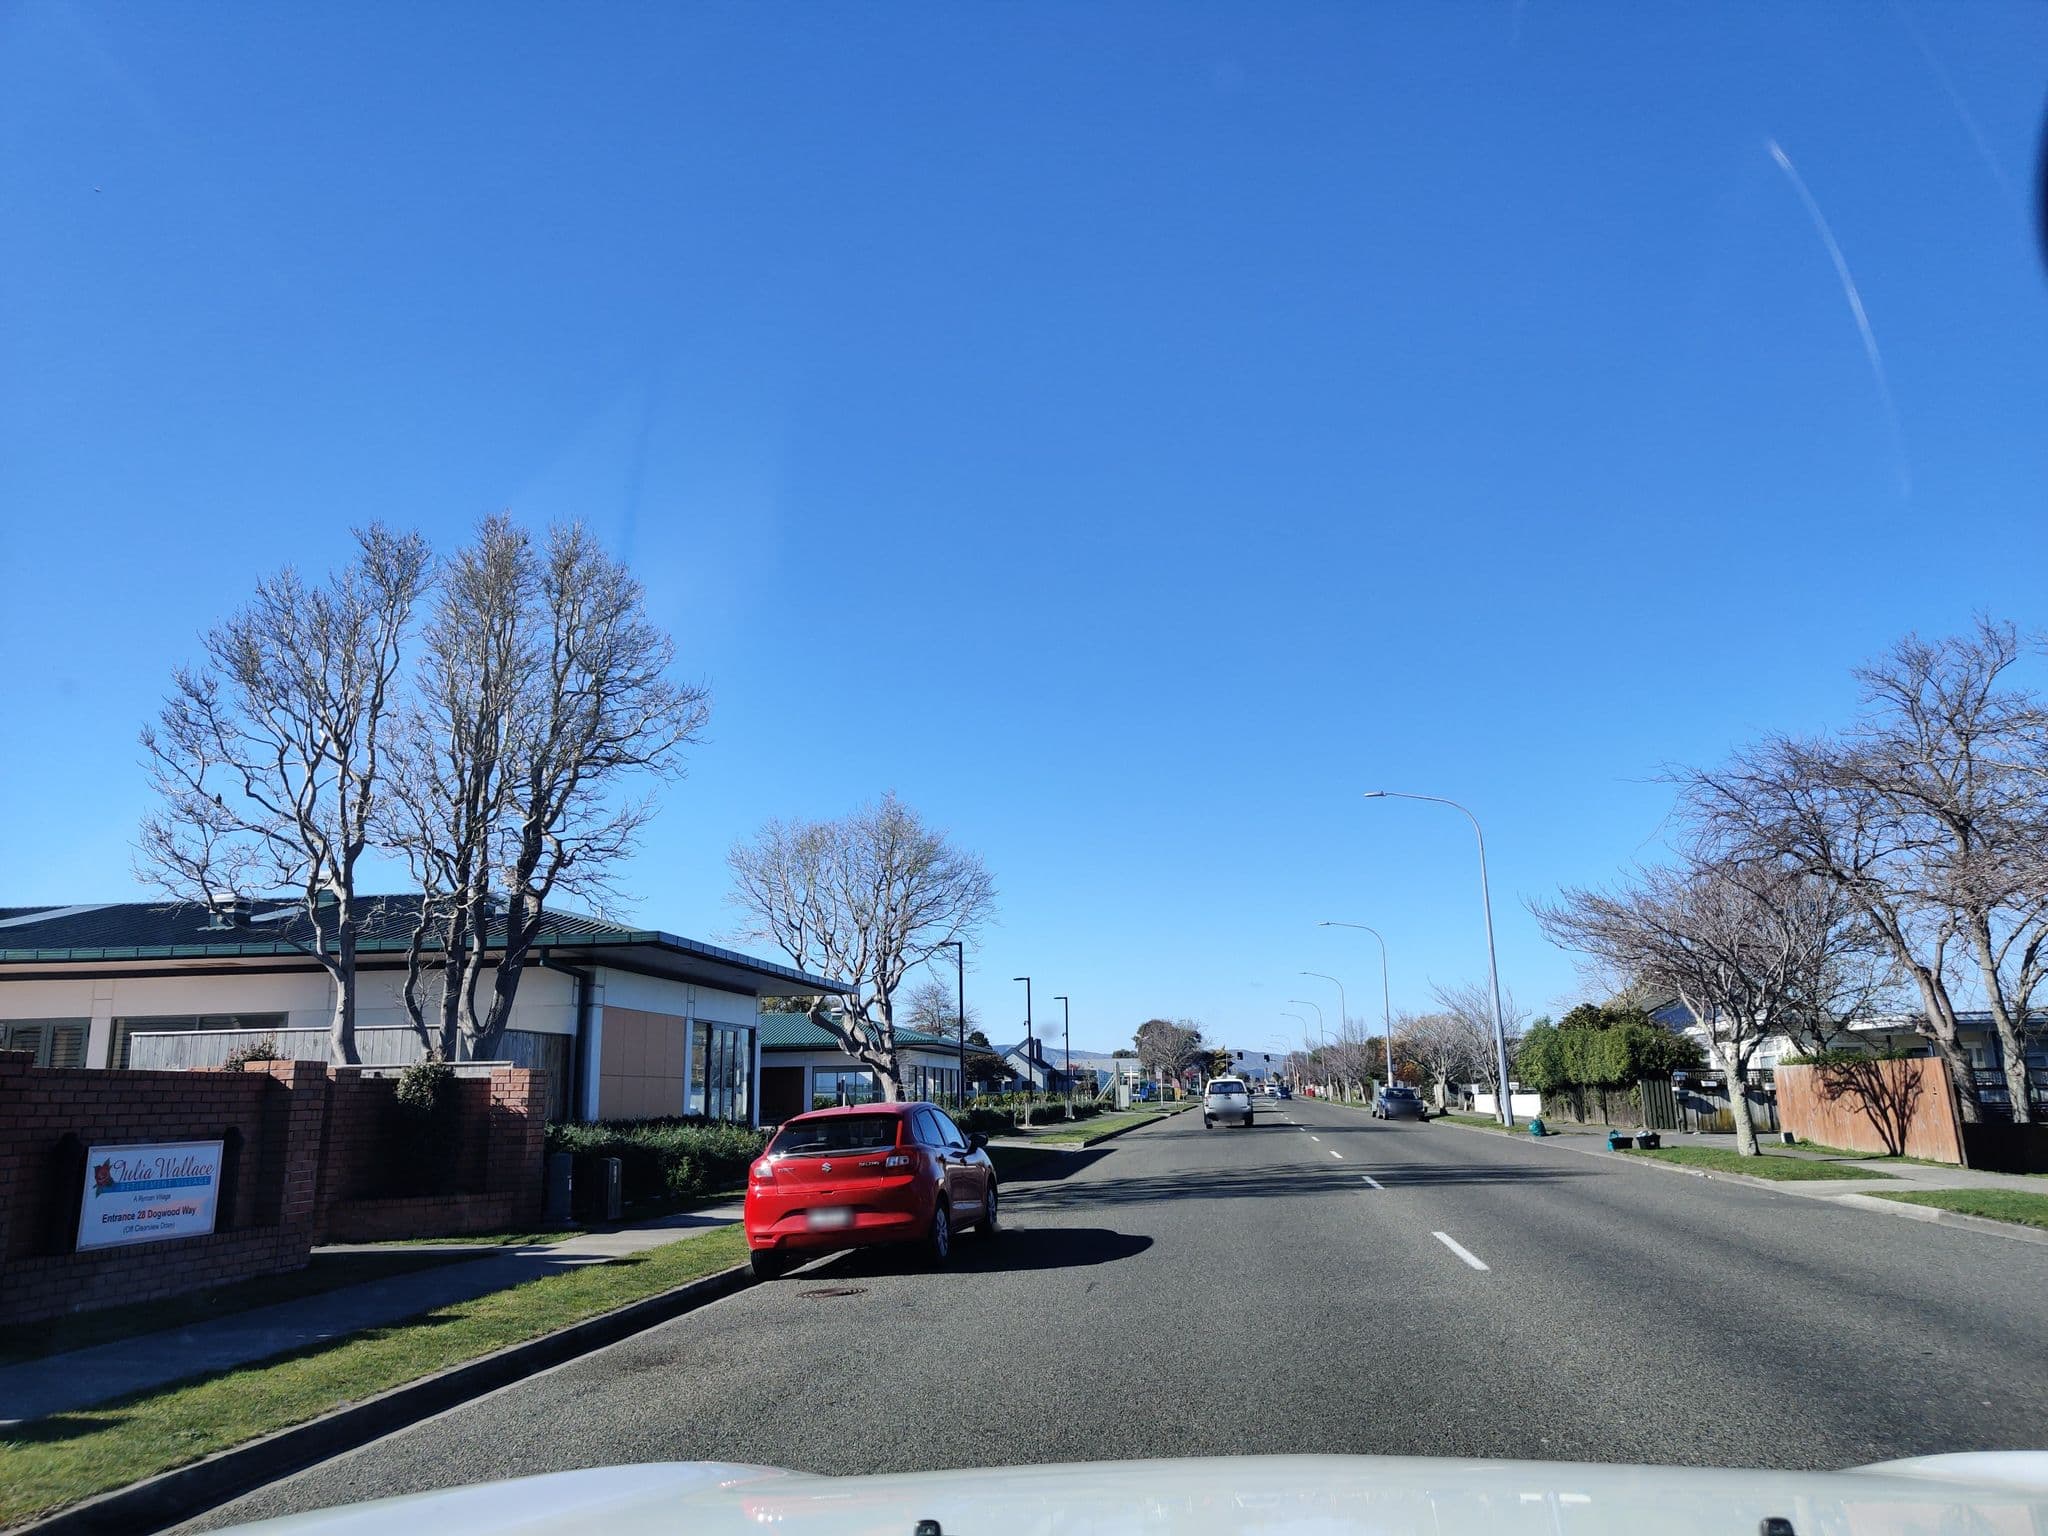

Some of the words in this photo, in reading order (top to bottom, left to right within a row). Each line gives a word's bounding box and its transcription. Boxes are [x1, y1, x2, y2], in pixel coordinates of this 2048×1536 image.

[113, 1158, 153, 1182] Julia
[155, 1156, 214, 1178] Wallace
[176, 1176, 209, 1186] VILLAGE
[102, 1213, 135, 1224] Entrance
[137, 1211, 146, 1220] 28
[147, 1207, 180, 1220] Dogwood
[182, 1206, 197, 1216] Way
